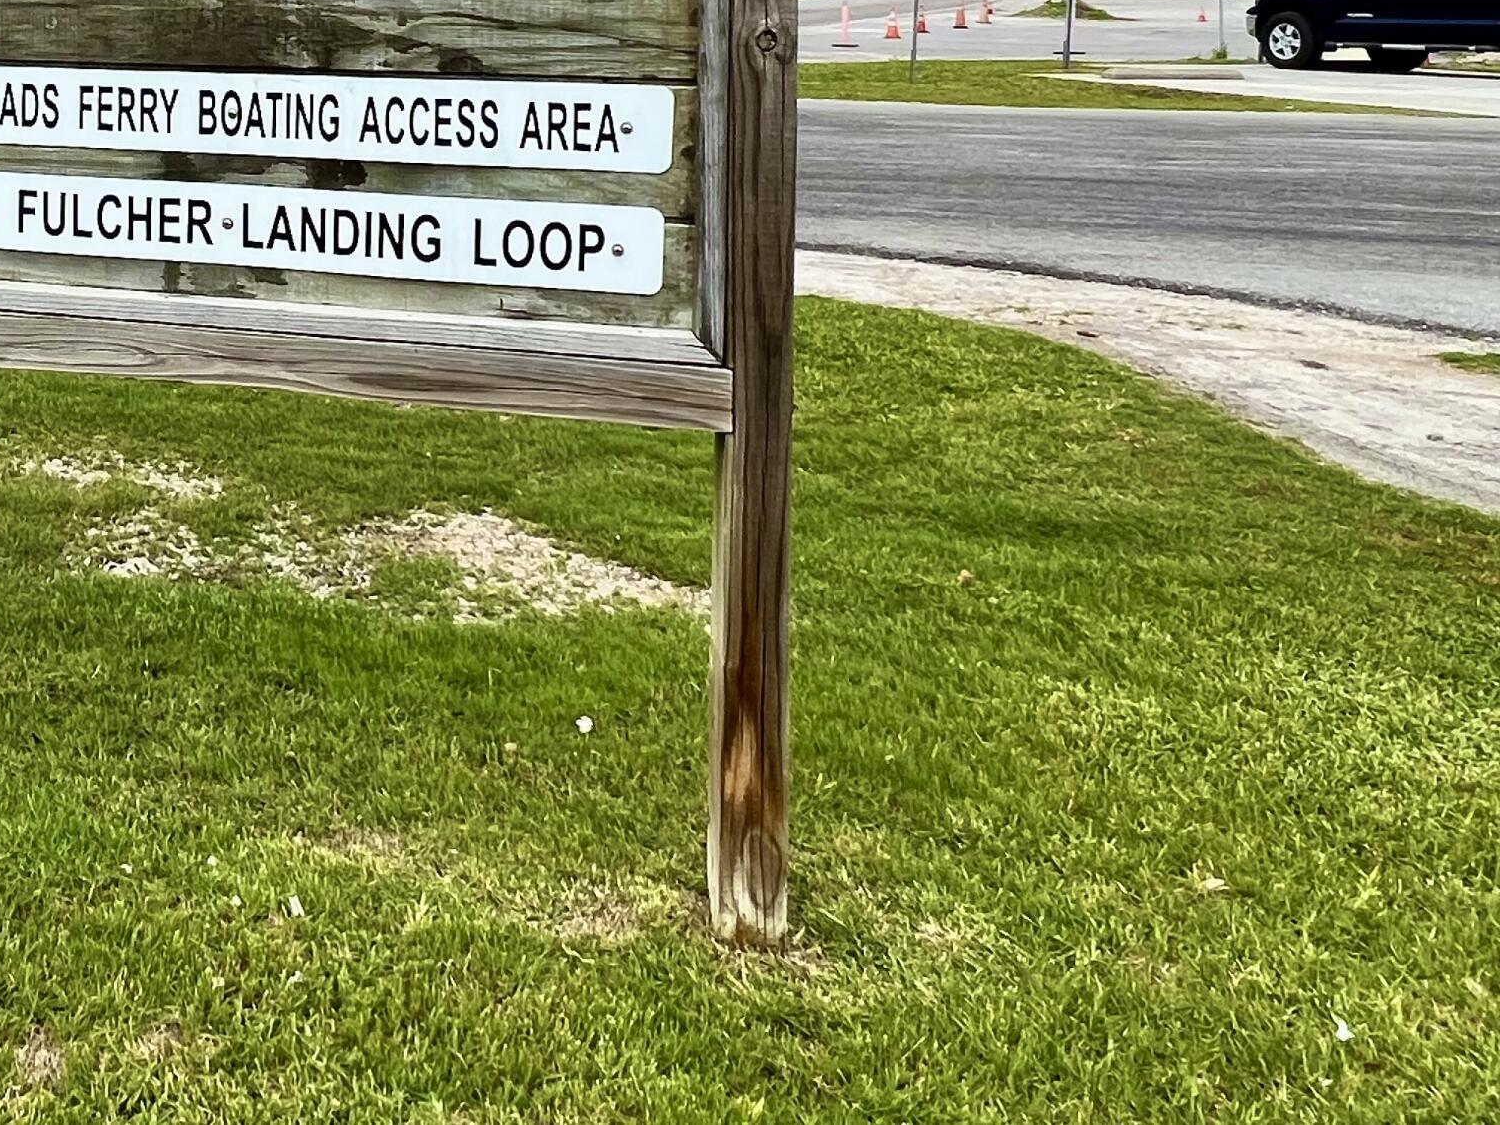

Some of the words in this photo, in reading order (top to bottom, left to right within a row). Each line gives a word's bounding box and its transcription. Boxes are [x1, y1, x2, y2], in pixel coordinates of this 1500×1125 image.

[80, 86, 179, 133] FERRY
[199, 90, 339, 142] BOATING
[359, 97, 498, 148] ACCESS
[519, 102, 621, 152] AREA
[19, 190, 213, 245] FULCHER
[243, 203, 440, 262] LANDING
[474, 218, 605, 271] LOOP
